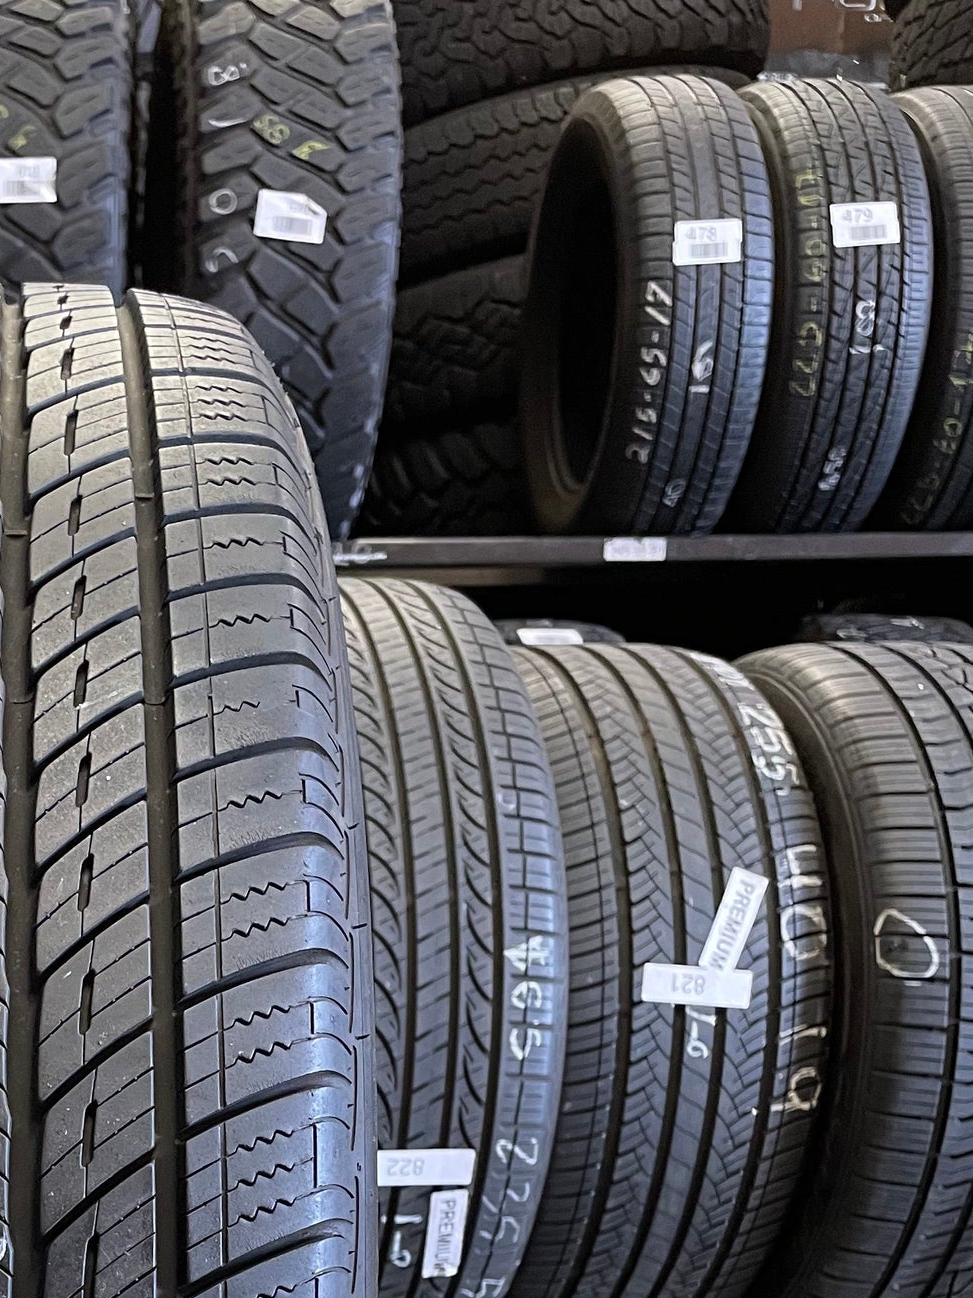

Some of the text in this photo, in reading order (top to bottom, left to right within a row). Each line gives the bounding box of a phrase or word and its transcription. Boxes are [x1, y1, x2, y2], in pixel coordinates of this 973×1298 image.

[843, 208, 874, 223] 479
[709, 878, 756, 972] PREMIUM
[671, 974, 706, 995] 821
[387, 1158, 425, 1177] 822
